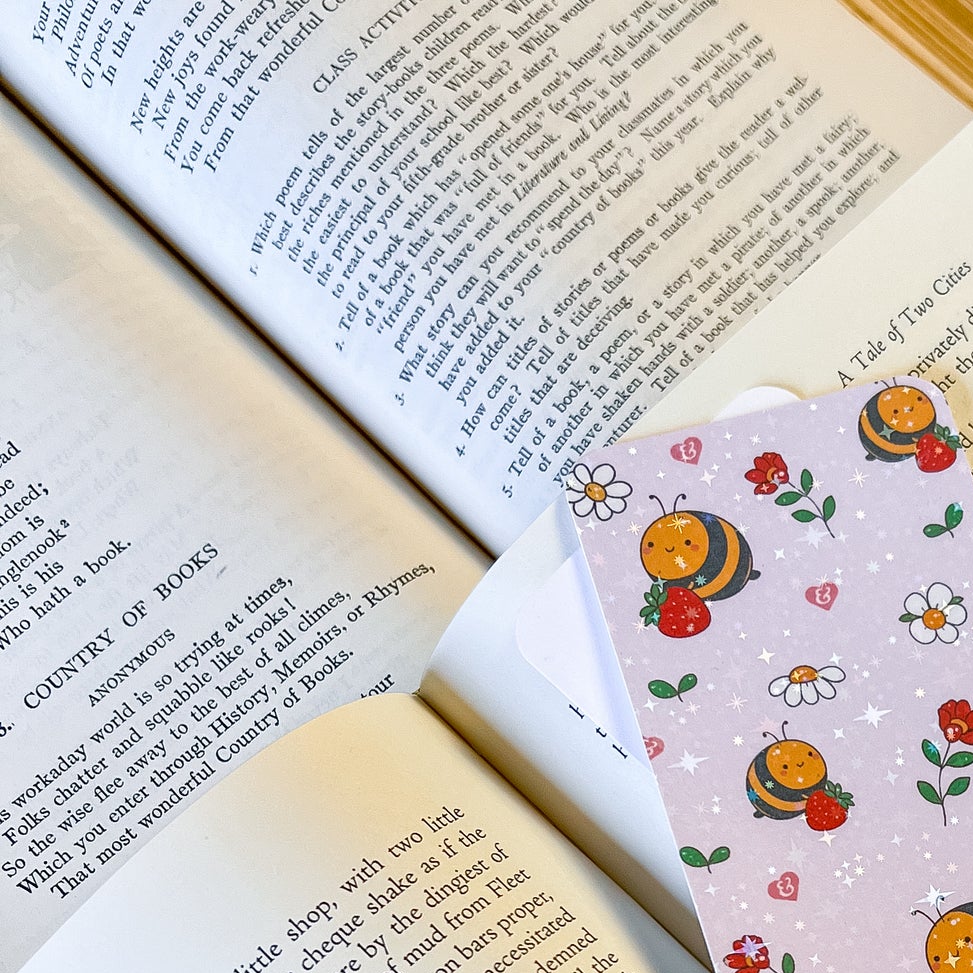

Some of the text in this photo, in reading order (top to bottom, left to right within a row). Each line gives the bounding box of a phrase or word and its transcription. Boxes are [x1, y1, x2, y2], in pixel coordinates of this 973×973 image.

[151, 0, 237, 131] New joys found
[202, 10, 325, 174] From that wonderful
[250, 4, 458, 255] Which poem tells of the largest number
[312, 47, 359, 94] CLASS
[502, 295, 635, 445] titles that are deceiving.
[836, 369, 856, 390] A
[849, 339, 888, 371] Tale
[887, 318, 906, 345] of
[897, 296, 935, 327] Two
[931, 261, 972, 296] Cities
[10, 576, 294, 809] workaday world is so trying at times,
[23, 542, 219, 710] COUNTRY OF BOOKS
[87, 628, 176, 708] ANONYMOUS
[49, 649, 355, 900] That most wonderful Country of Books.
[301, 914, 365, 972] cheque
[366, 872, 419, 916] shake
